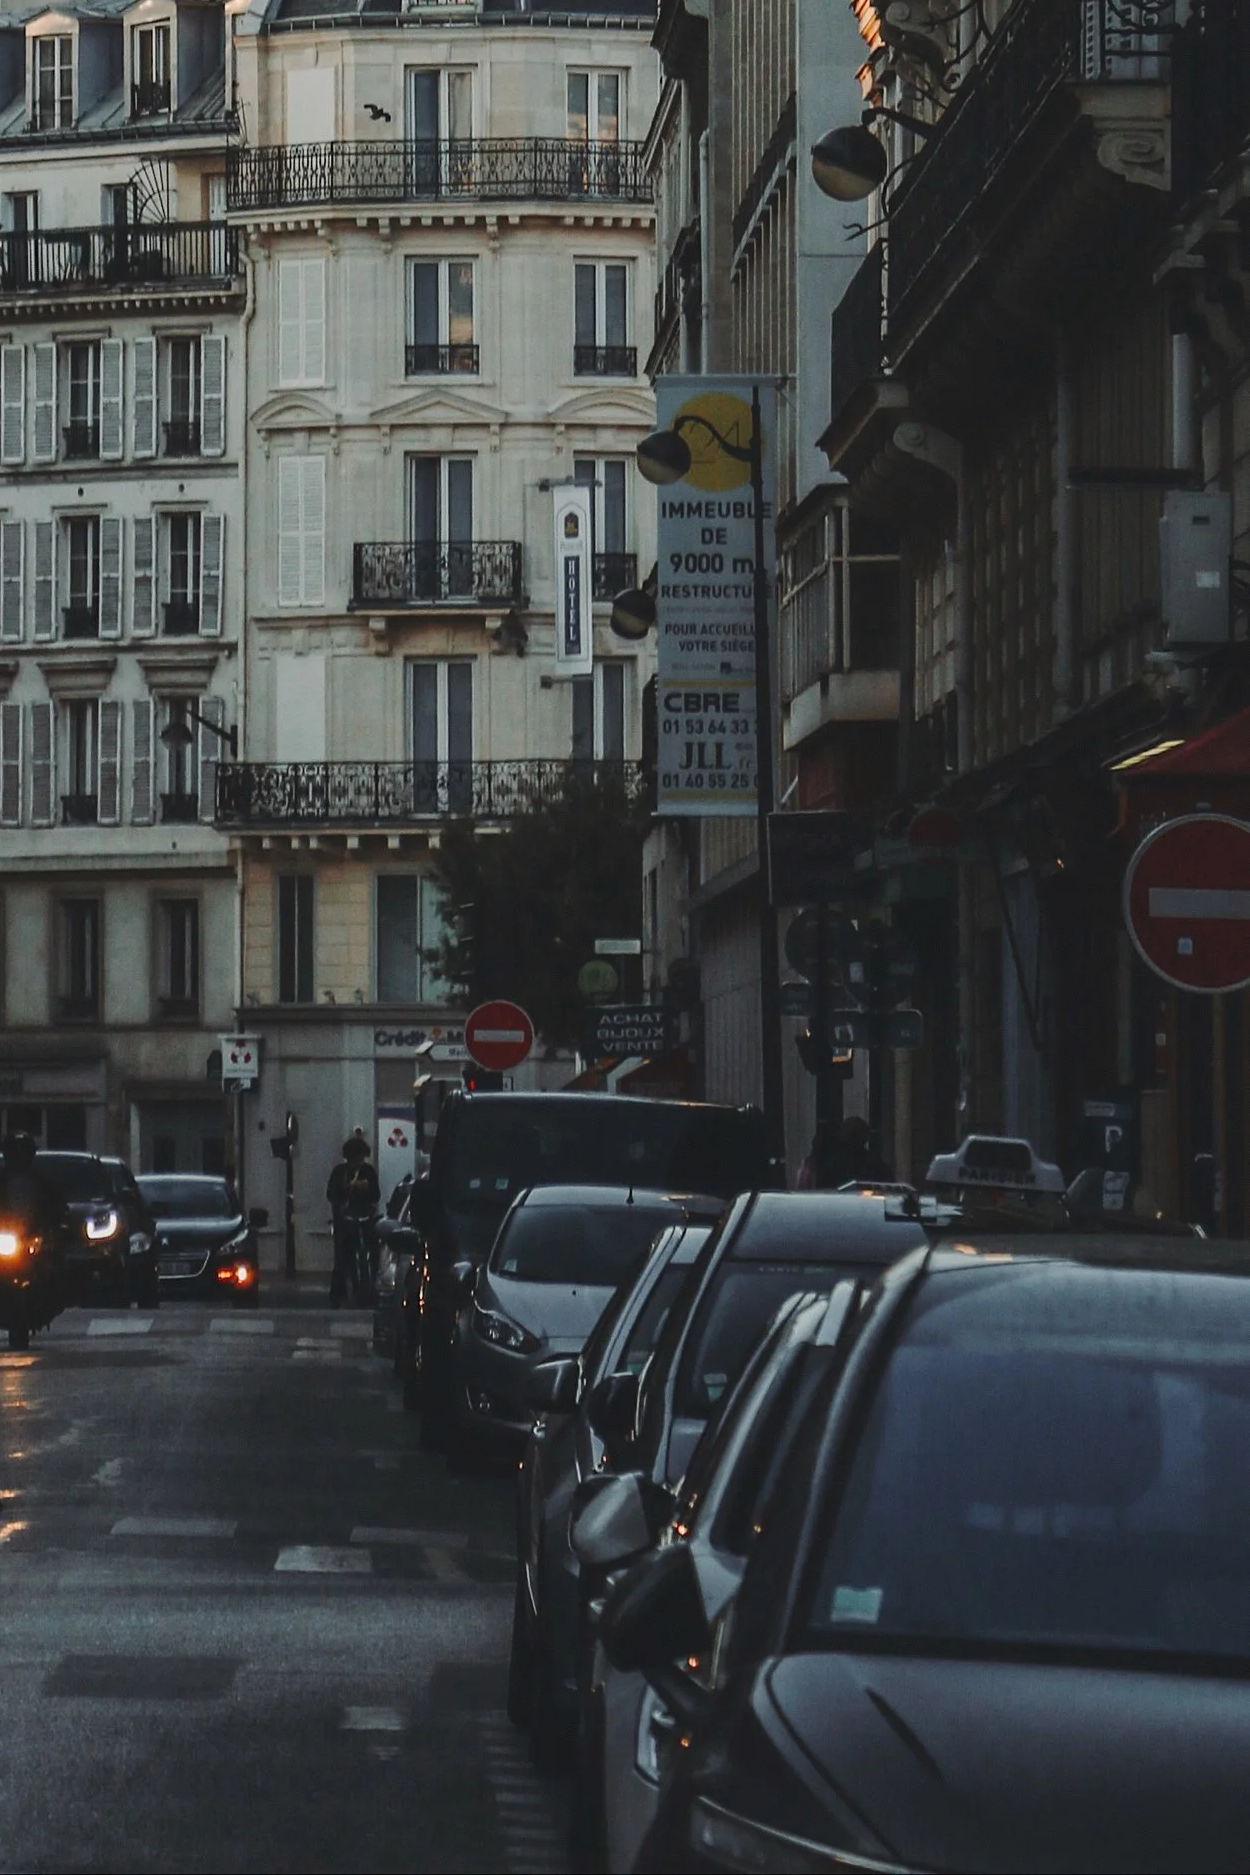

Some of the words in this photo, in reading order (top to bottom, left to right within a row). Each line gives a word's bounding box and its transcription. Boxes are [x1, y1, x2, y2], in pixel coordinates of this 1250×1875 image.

[661, 501, 772, 519] IMMEUBLE
[700, 528, 728, 545] DE
[669, 553, 724, 574] 9000
[567, 559, 577, 642] HOTEL
[664, 623, 697, 635] POUR
[678, 640, 717, 653] VOTRE
[663, 692, 740, 714] CBRE
[662, 719, 680, 735] 01
[685, 719, 704, 735] 53
[708, 719, 727, 735] 64
[730, 720, 750, 735] 33
[678, 741, 733, 770] JLL
[662, 773, 680, 789] 01
[685, 773, 704, 789] 40
[708, 773, 727, 789] 55
[730, 773, 750, 789] 25
[598, 1012, 663, 1026] ACHAT
[596, 1027, 664, 1040] BIJOUX
[601, 1039, 664, 1052] VENTE
[1104, 1124, 1123, 1153] P
